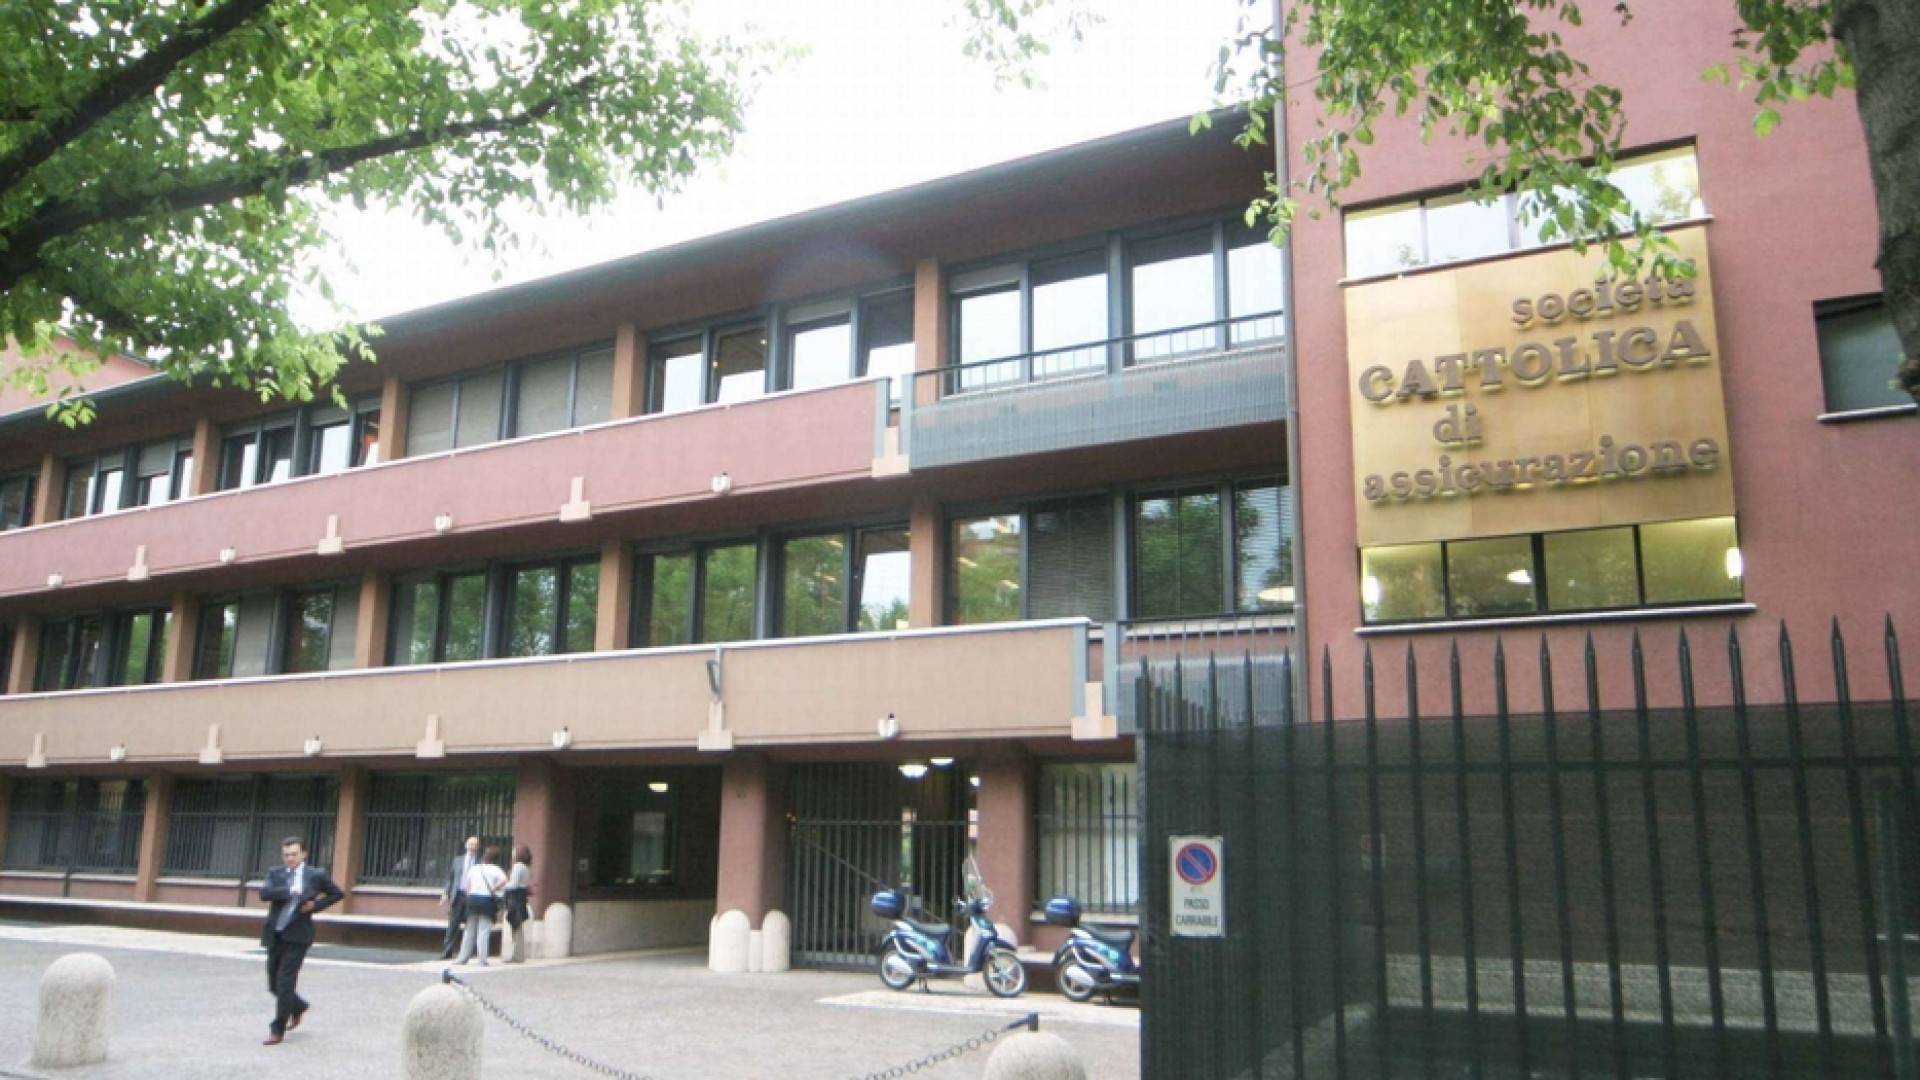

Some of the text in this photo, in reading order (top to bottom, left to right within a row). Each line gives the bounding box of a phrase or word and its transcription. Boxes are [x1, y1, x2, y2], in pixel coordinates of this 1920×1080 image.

[1358, 319, 1712, 402] CATTOLICA
[1432, 404, 1483, 444] di
[1363, 434, 1720, 501] assicurazione
[1183, 897, 1210, 910] PASSO
